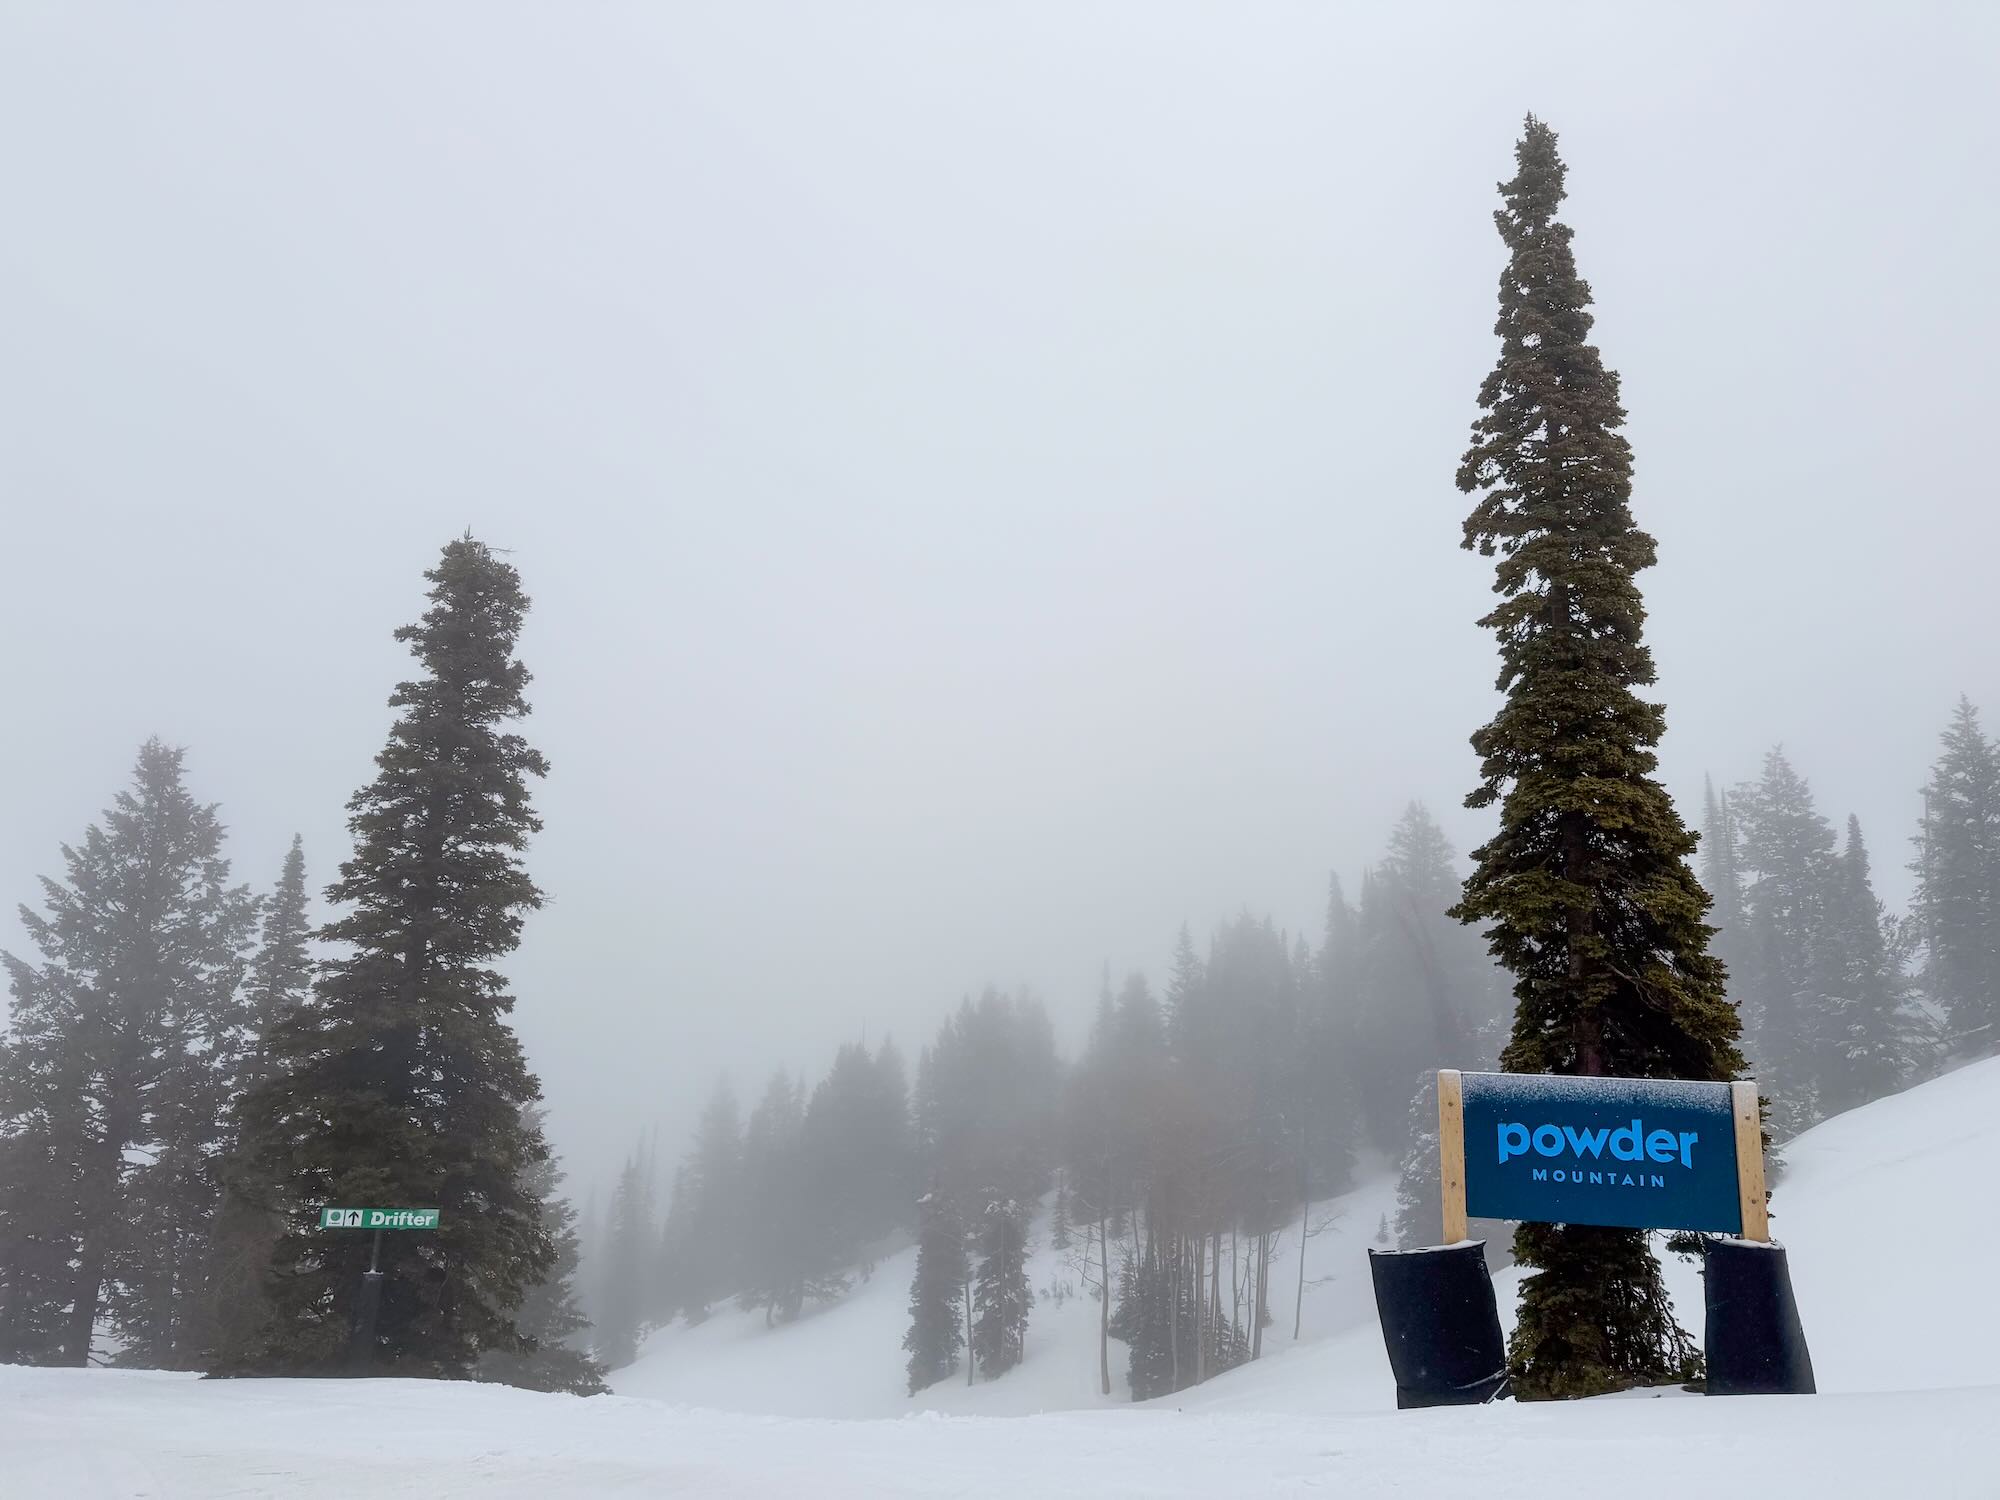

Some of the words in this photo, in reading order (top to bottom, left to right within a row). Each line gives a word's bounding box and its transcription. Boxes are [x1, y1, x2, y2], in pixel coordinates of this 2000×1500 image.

[1497, 1119, 1699, 1169] powder
[1532, 1168, 1665, 1188] MOUNTAIN
[370, 1211, 434, 1226] Drifter
